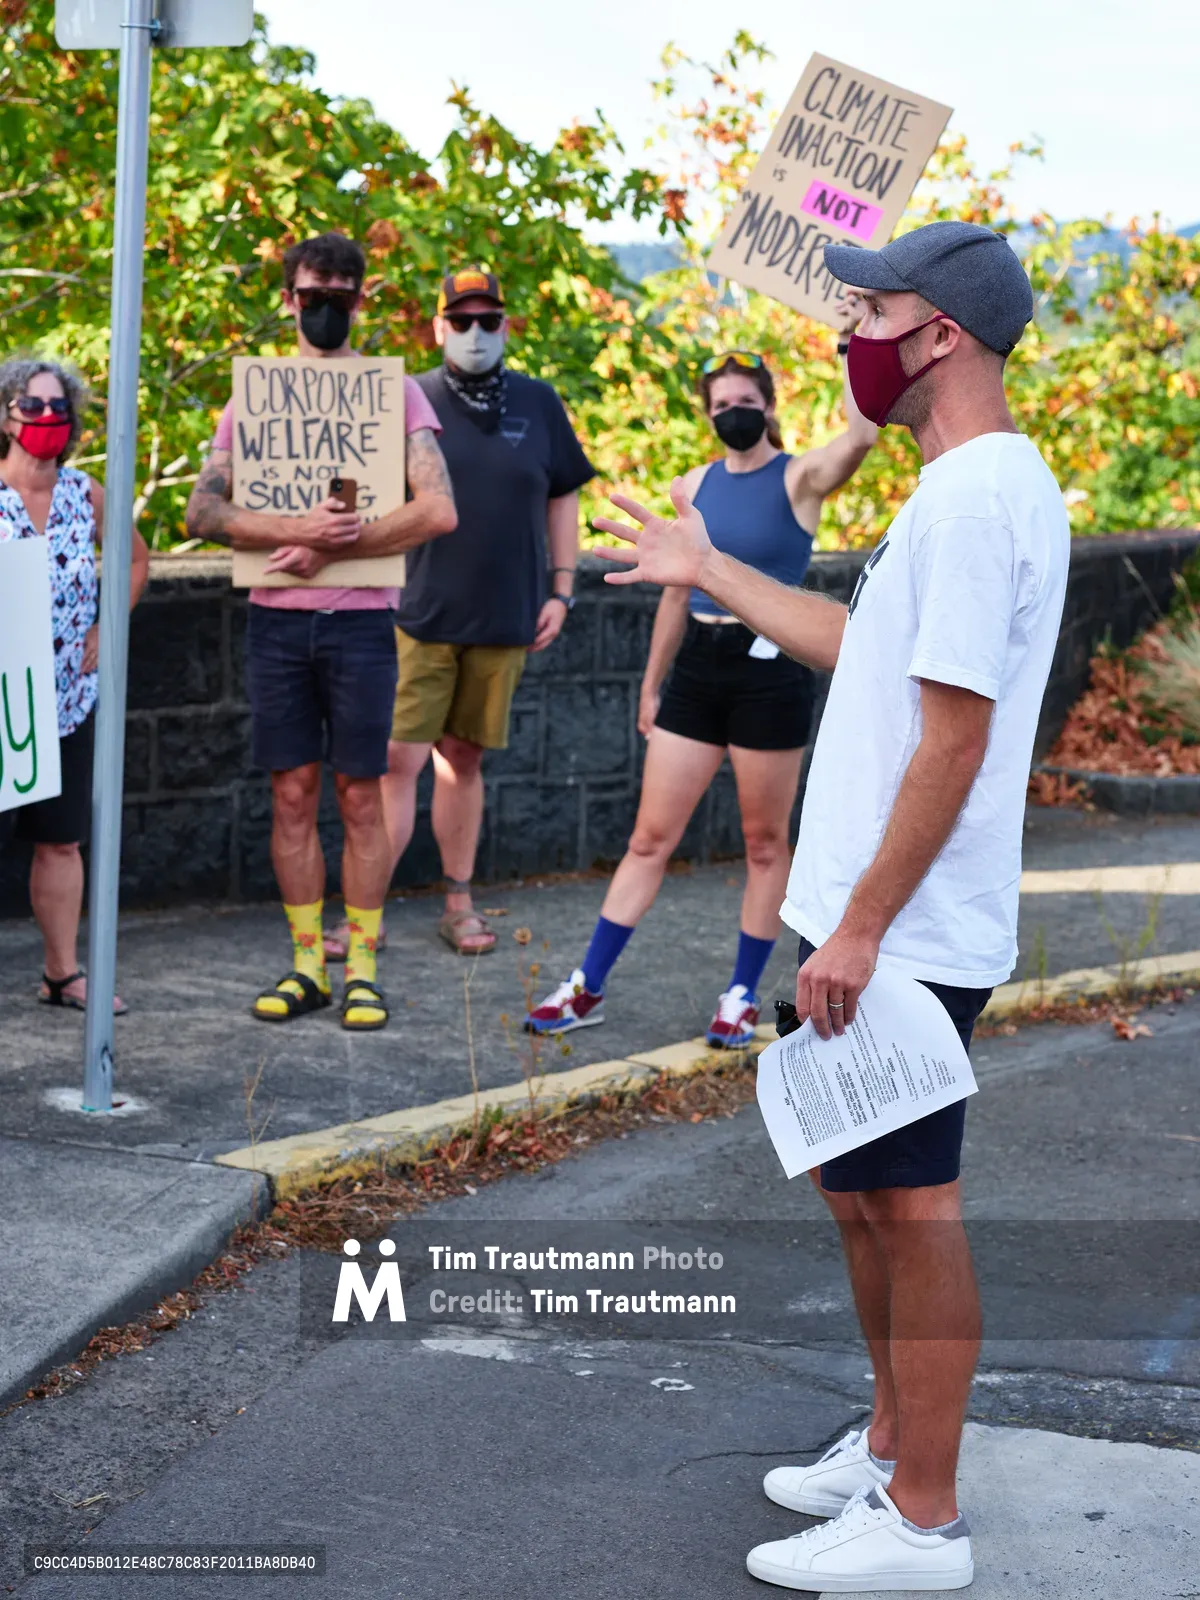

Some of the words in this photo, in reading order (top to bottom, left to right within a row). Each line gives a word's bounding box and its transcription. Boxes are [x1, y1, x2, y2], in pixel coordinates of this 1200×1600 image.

[803, 67, 921, 152] CLIMATE
[778, 114, 903, 200] INACTION
[813, 188, 868, 228] NOT
[245, 364, 394, 420] CORPORATE
[238, 418, 381, 466] WELFARE
[294, 465, 344, 480] NOT
